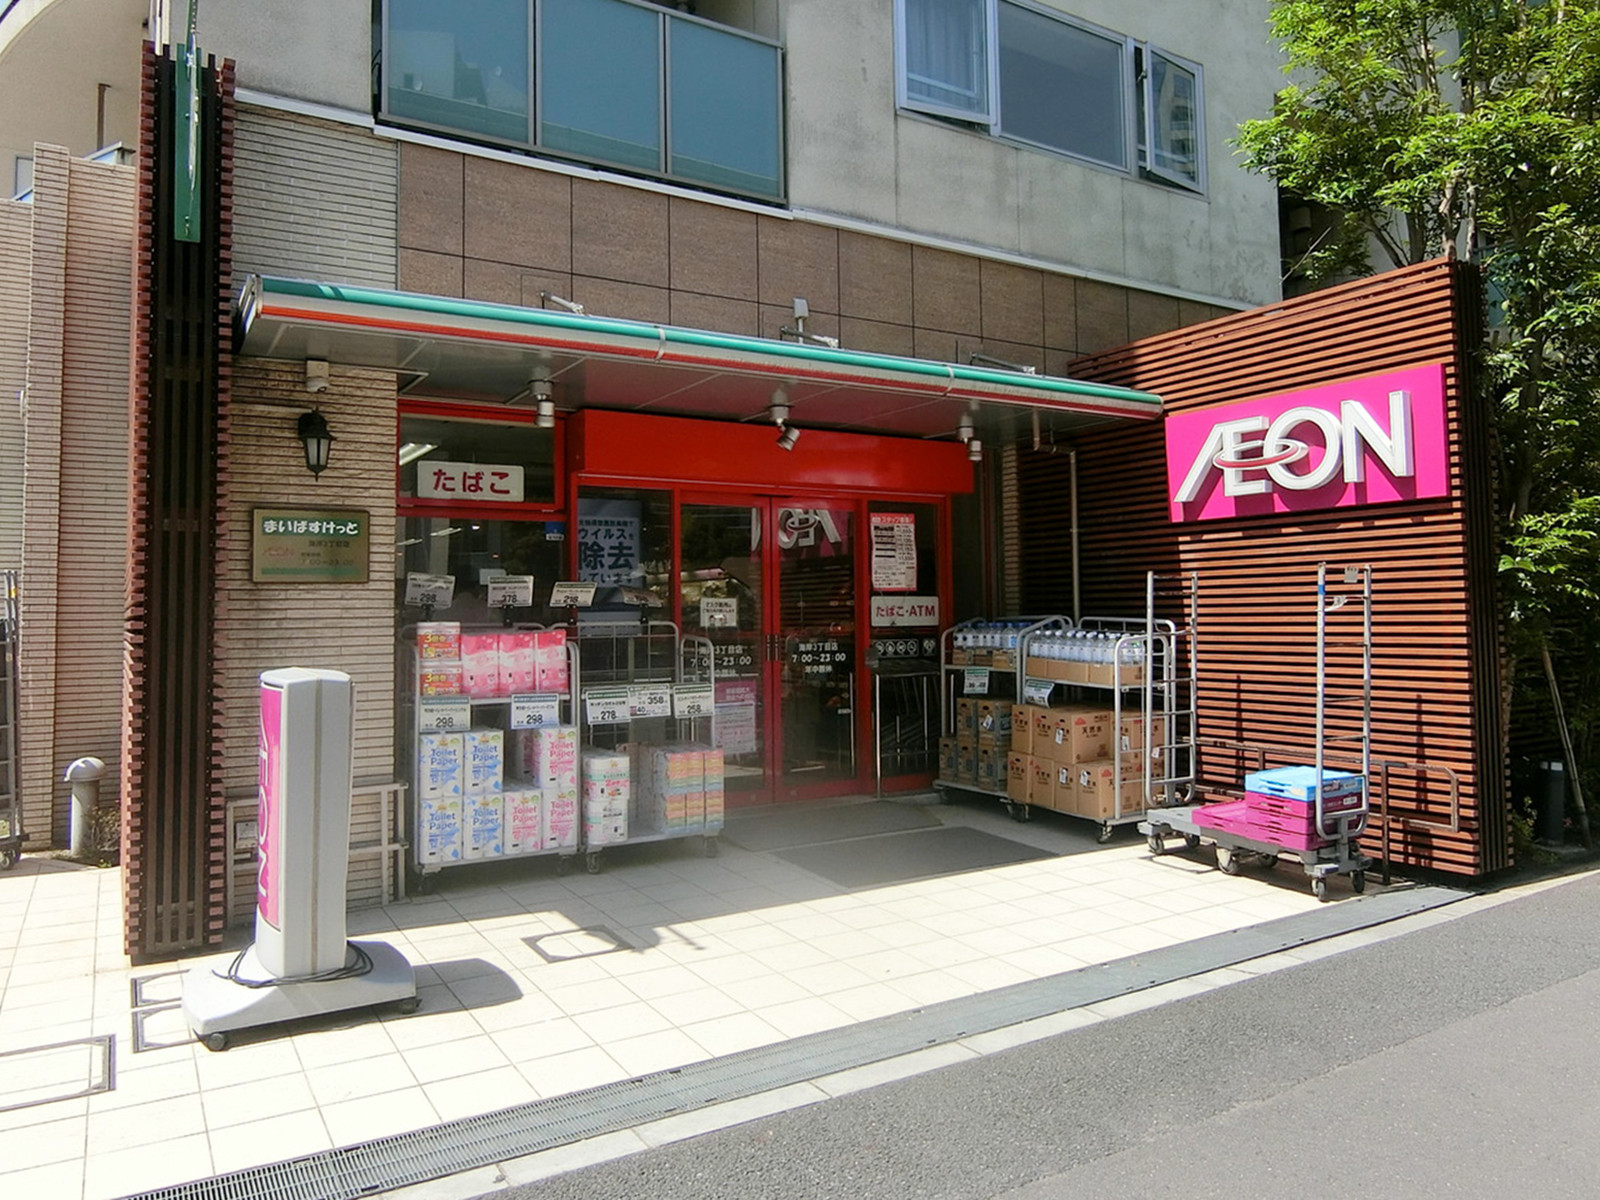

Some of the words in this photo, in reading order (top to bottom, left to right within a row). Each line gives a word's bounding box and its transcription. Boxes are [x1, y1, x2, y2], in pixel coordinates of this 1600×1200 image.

[433, 469, 510, 494] たばこ
[263, 520, 358, 534] まいばすけっと
[579, 541, 635, 570] 除去
[527, 714, 543, 724] 298
[601, 710, 617, 720] 278
[436, 717, 454, 728] 298
[430, 748, 456, 757] Toilet
[473, 745, 498, 753] Toilet
[430, 757, 458, 766] Paper
[473, 753, 499, 763] Paper
